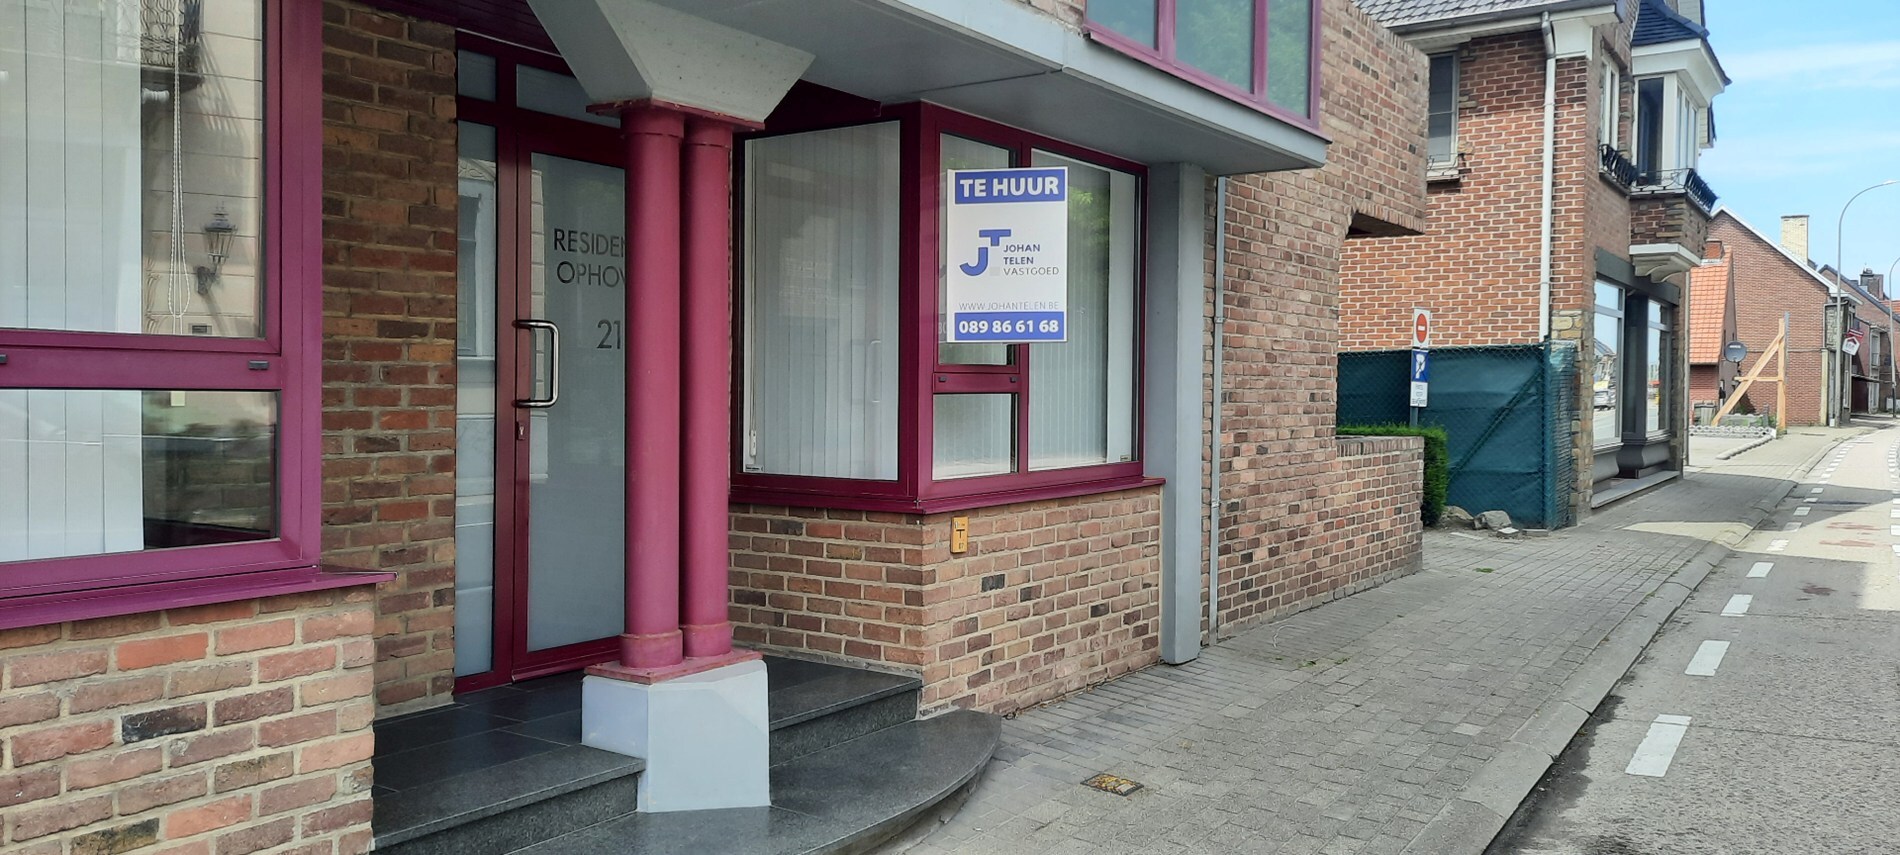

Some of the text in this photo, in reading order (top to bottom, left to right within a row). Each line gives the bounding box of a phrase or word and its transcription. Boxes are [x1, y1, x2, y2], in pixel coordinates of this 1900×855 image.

[960, 176, 1059, 198] TE HUUR
[1003, 244, 1041, 253] JOHAN
[1003, 257, 1034, 265] TELEN
[1003, 266, 1060, 276] VASTGOED
[959, 320, 989, 334] 089
[992, 320, 1012, 333] 86
[1015, 320, 1034, 333] 61
[1039, 319, 1059, 333] 68
[596, 319, 621, 349] 21
